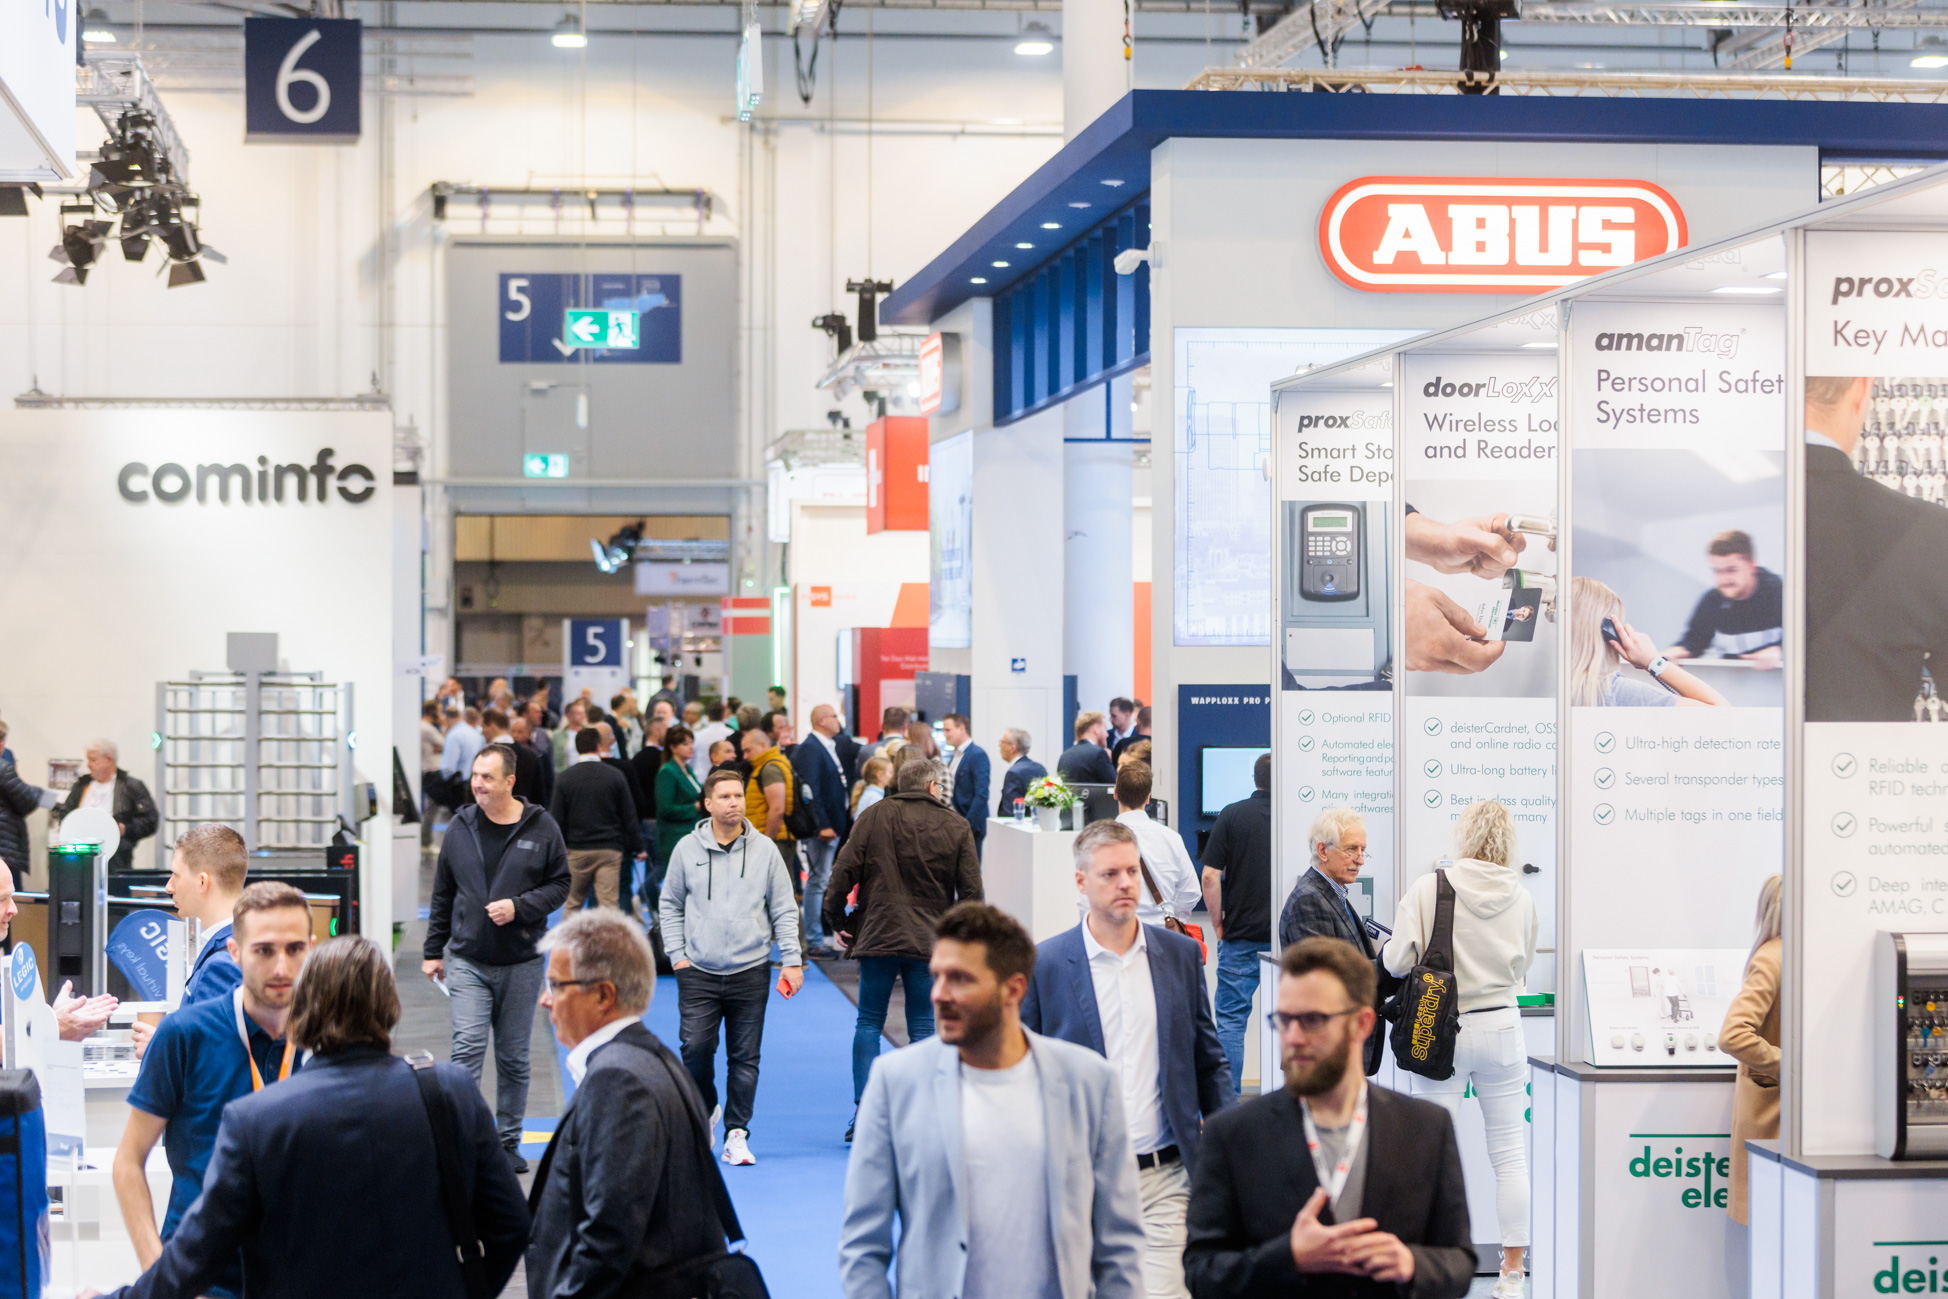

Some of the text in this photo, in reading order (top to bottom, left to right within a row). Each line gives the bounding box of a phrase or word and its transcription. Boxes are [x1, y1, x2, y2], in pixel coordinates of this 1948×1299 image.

[275, 28, 331, 124] 6
[1373, 203, 1636, 266] ABUS
[505, 278, 532, 322] 5
[1833, 319, 1888, 355] Key
[1597, 368, 1784, 394] Personal Safet
[1423, 412, 1518, 432] Wireless
[1596, 399, 1700, 430] Systems
[1298, 441, 1393, 460] Smart Sto
[1424, 438, 1558, 459] and Reader
[117, 447, 376, 504] cominfo
[1298, 464, 1394, 487] Safe Dep
[583, 626, 607, 664] 5
[1191, 697, 1239, 705] WAPPLOXX
[1243, 697, 1261, 705] PRO
[1322, 712, 1391, 724] Optional RFID
[1450, 721, 1530, 735] deisterCardnet,
[1321, 739, 1375, 749] Automated
[1450, 737, 1472, 749] and
[1475, 737, 1509, 749] online
[1513, 738, 1542, 750] radio
[1625, 736, 1781, 752] Ultra-high detection rate
[1321, 752, 1365, 765] Reporting
[1365, 753, 1384, 763] and
[1869, 757, 1928, 773] Reliable
[1321, 766, 1363, 776] software
[1450, 763, 1506, 778] Ultra-long
[1509, 763, 1548, 778] battery
[1624, 771, 1784, 788] Several transponder types
[1869, 780, 1906, 796] RFID
[1321, 790, 1349, 801] Many
[1450, 793, 1473, 805] Best
[1520, 795, 1556, 808] quality
[1624, 808, 1784, 824] Multiple tags in one field
[1868, 816, 1933, 833] Powerful
[1868, 876, 1910, 895] Deep
[1868, 898, 1927, 916] AMAG,
[13, 956, 34, 988] LEGIC
[1628, 1145, 1731, 1178] deiste
